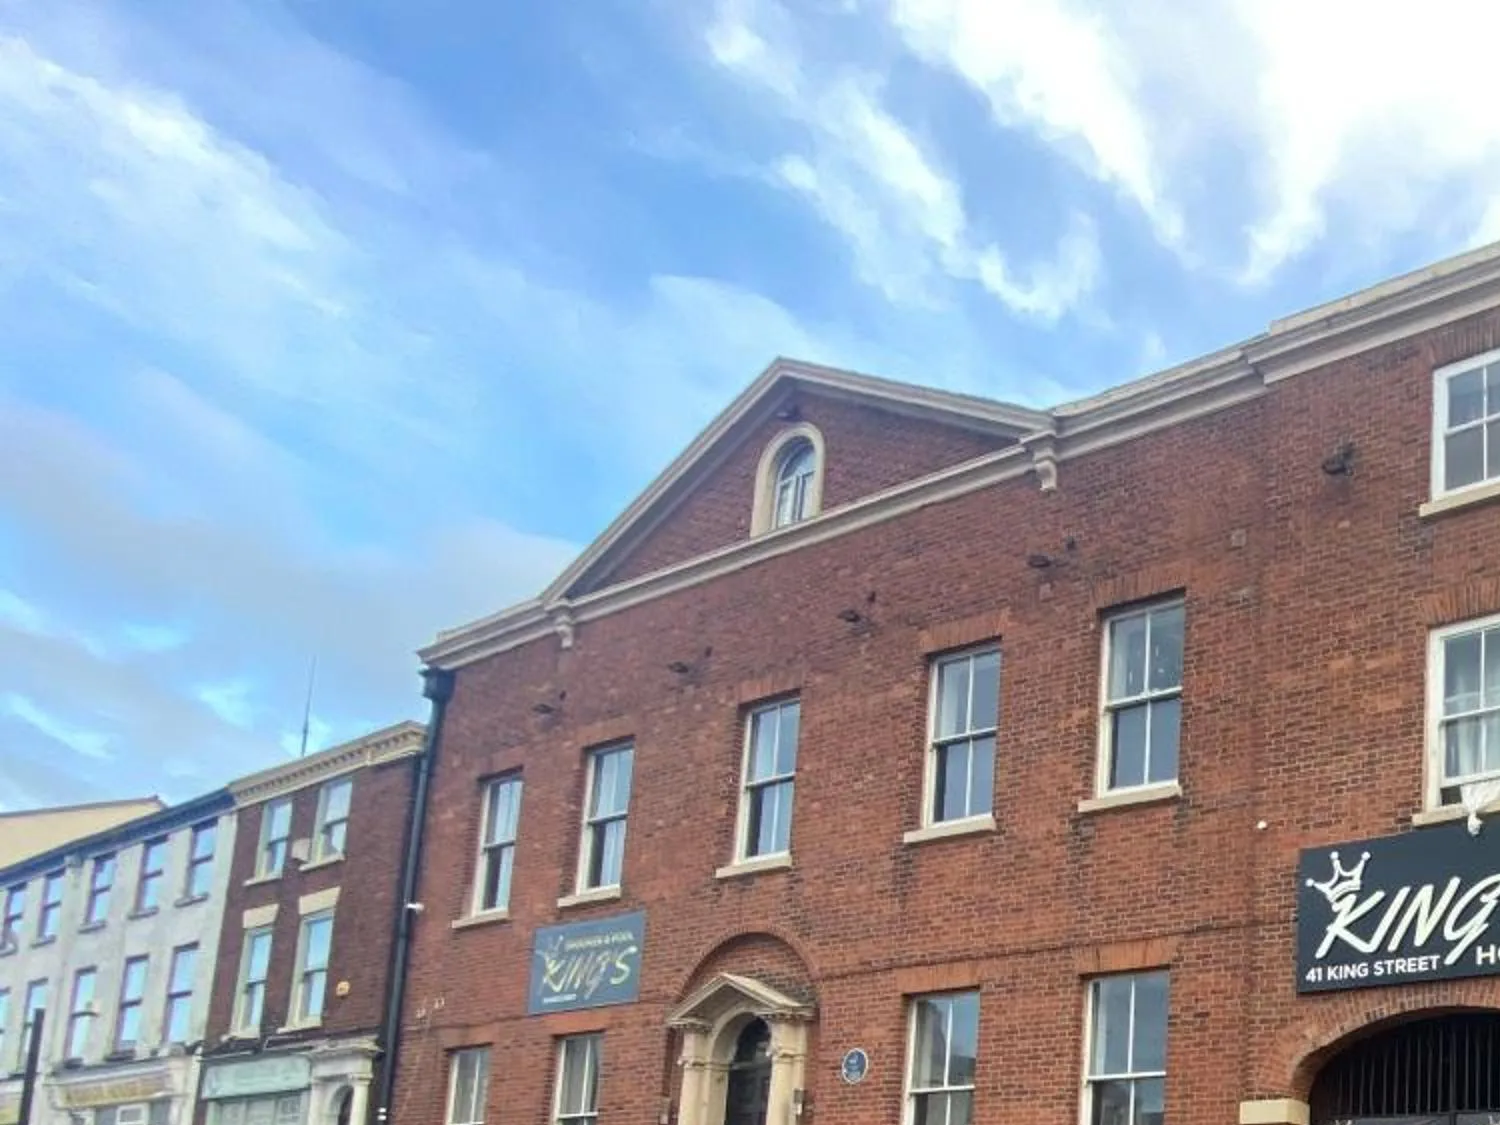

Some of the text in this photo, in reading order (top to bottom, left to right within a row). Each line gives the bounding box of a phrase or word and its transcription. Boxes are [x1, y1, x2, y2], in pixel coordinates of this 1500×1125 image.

[1305, 955, 1440, 982] 41 KING STREET
